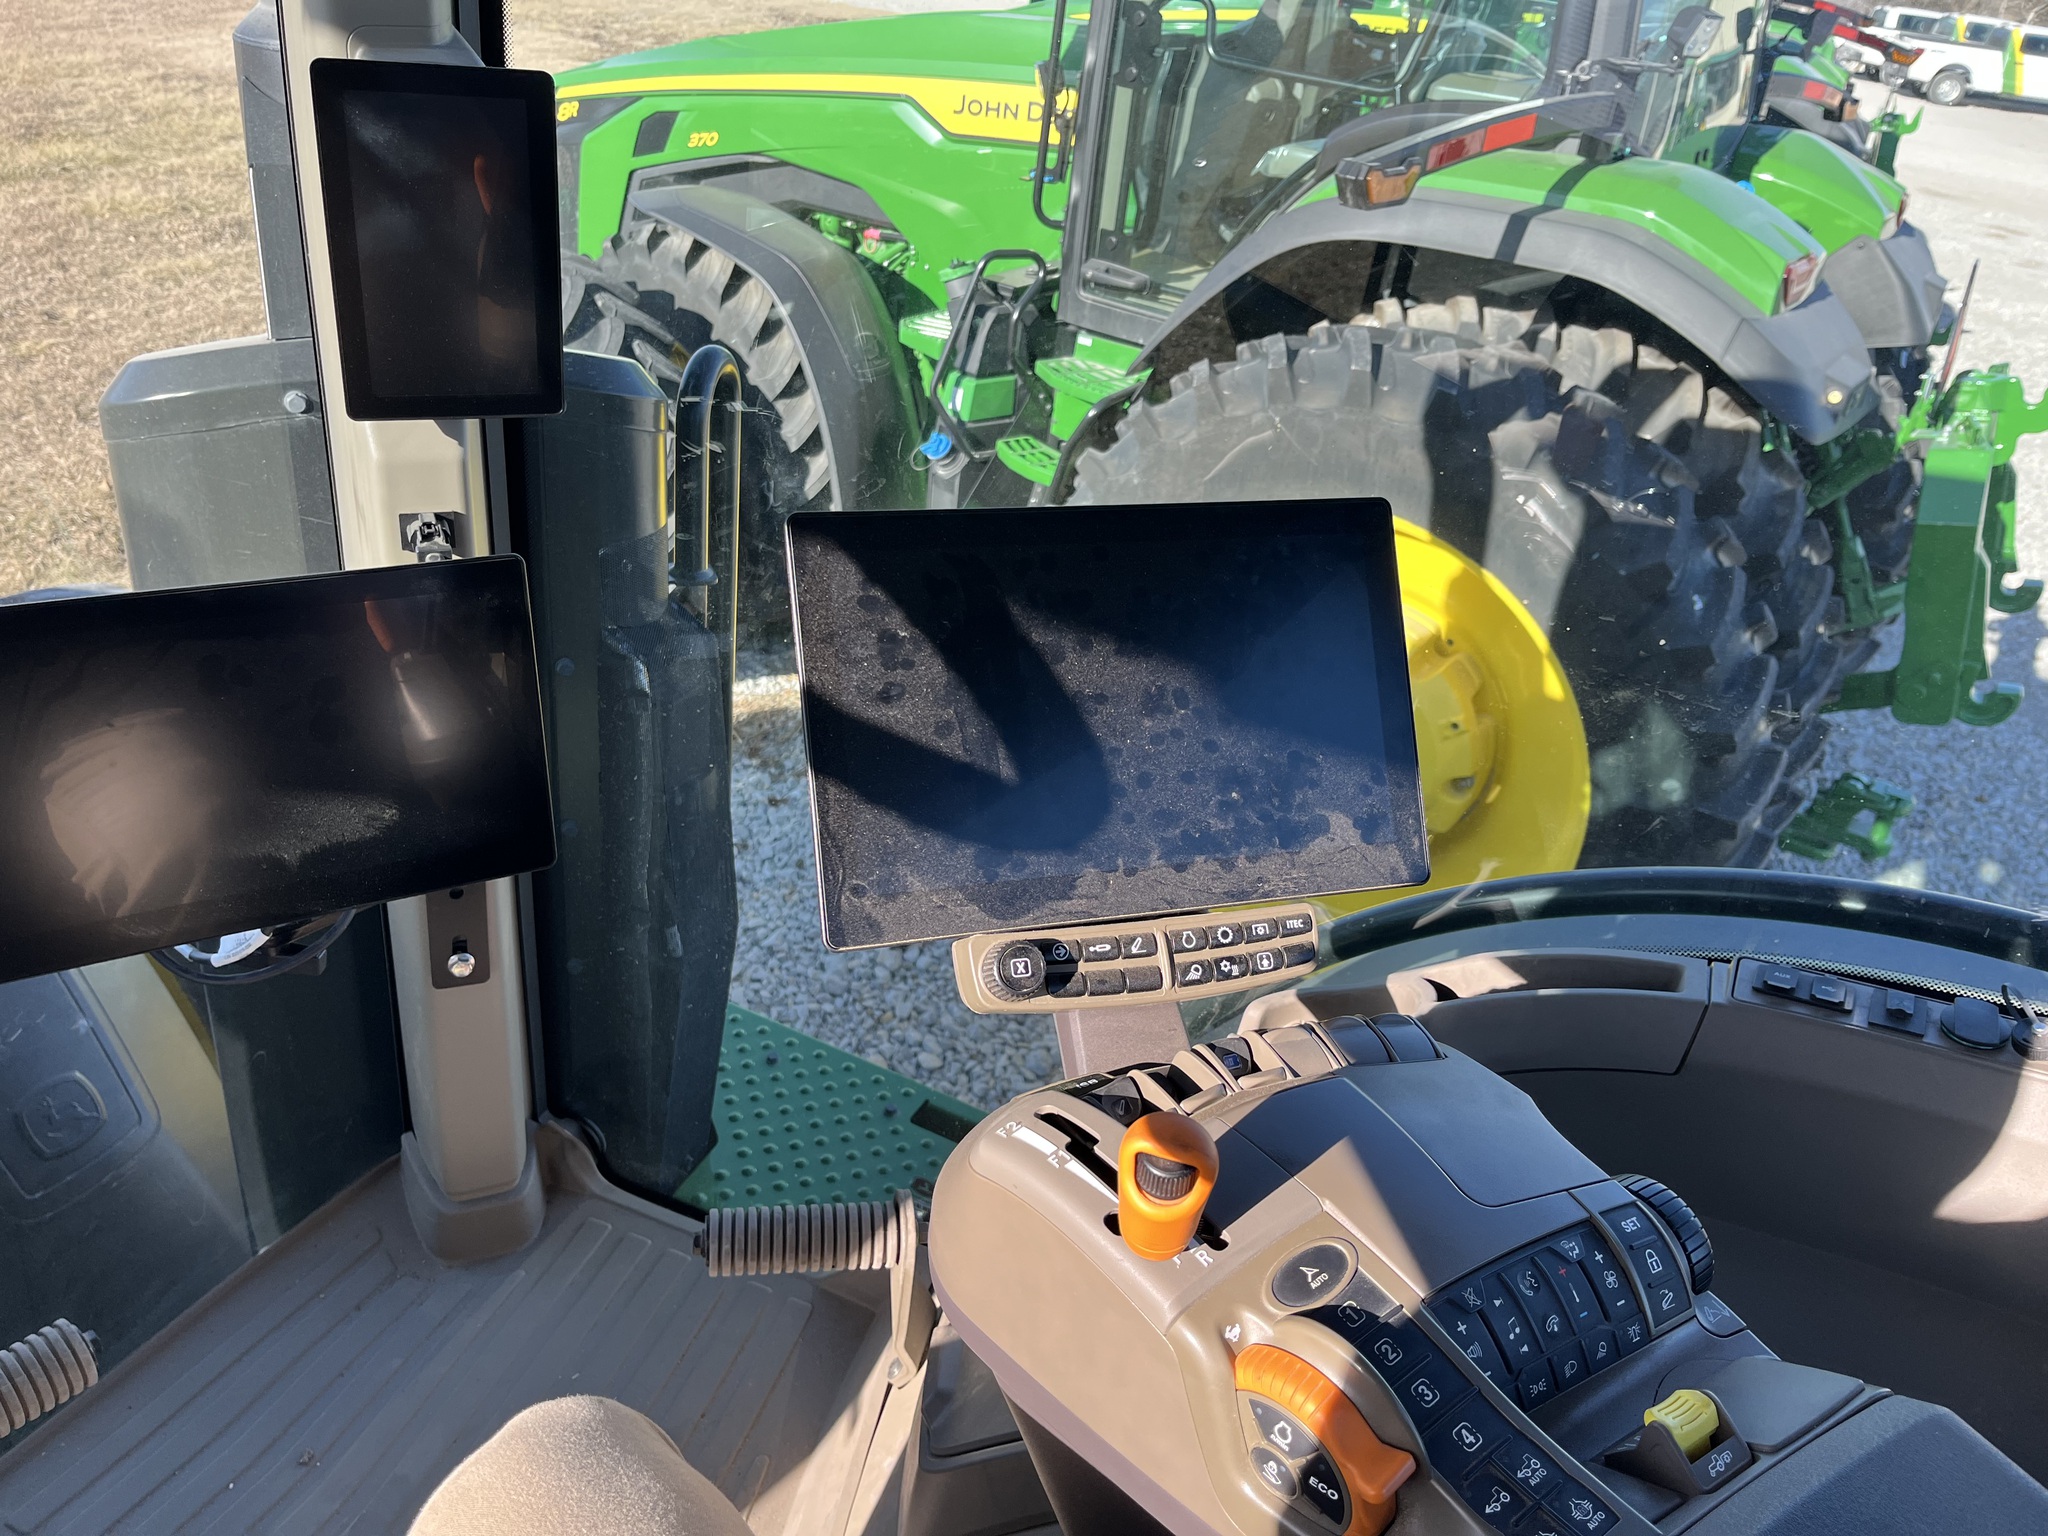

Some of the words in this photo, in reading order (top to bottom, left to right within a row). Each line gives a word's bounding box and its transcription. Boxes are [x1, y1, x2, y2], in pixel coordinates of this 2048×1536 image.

[557, 100, 580, 122] 8R
[953, 94, 1019, 120] JOHN
[687, 131, 719, 148] 370
[1286, 918, 1304, 929] ITEC
[1773, 971, 1791, 979] AUX
[995, 1121, 1022, 1138] F2
[1047, 1149, 1071, 1169] F1
[1621, 1216, 1641, 1233] SET
[1194, 1250, 1214, 1268] R
[1310, 1272, 1329, 1290] AUTO
[1528, 1468, 1547, 1487] AUTO
[1308, 1475, 1339, 1500] ECO
[1586, 1511, 1606, 1531] AUTO
